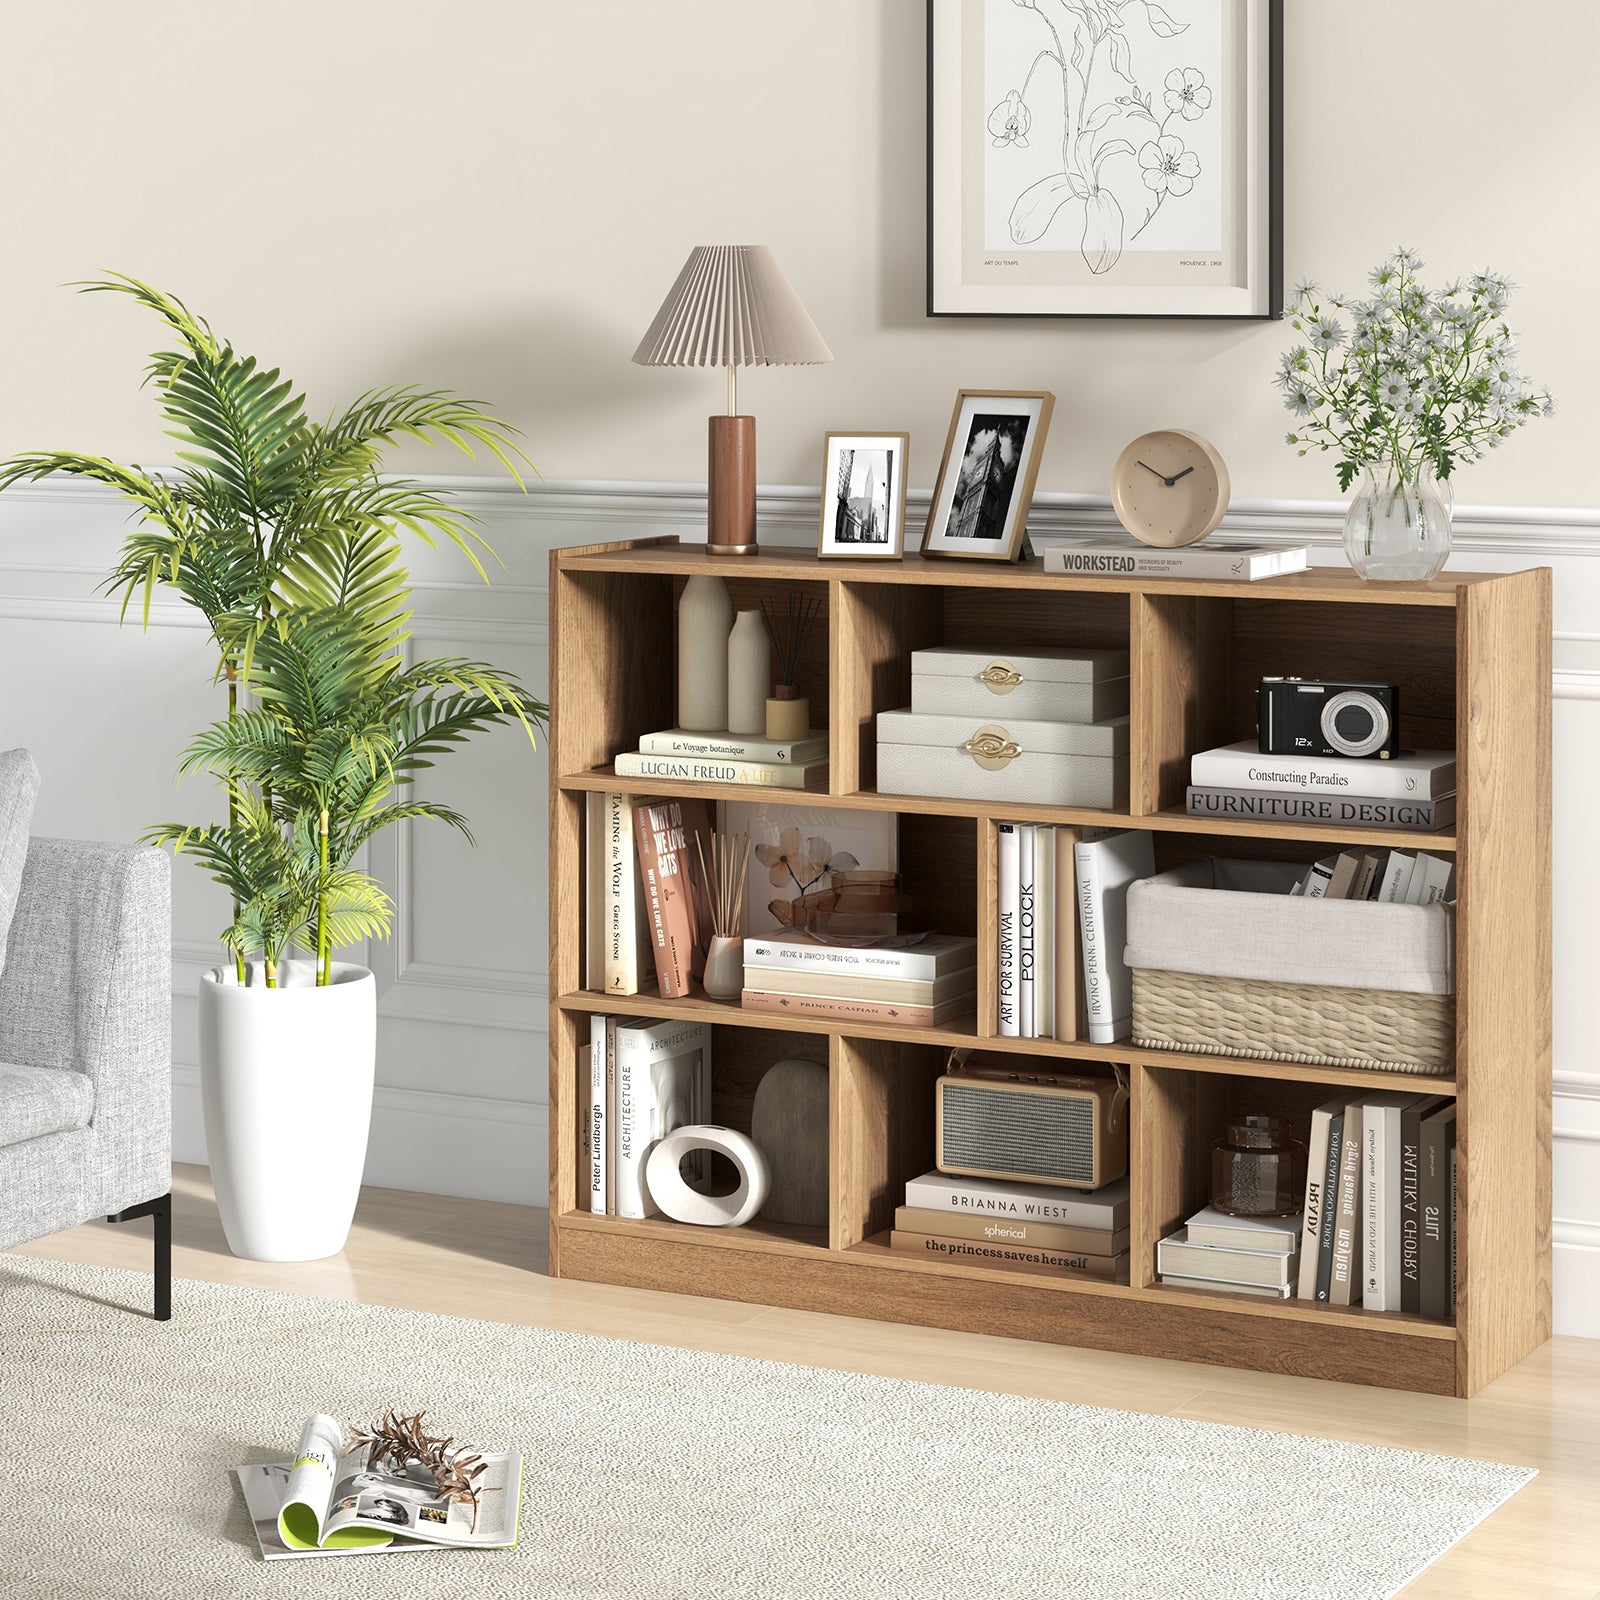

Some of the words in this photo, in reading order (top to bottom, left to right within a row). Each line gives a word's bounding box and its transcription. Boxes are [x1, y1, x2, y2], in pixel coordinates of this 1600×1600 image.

[1063, 554, 1135, 572] WORKSTEAD
[672, 742, 681, 750] Le
[683, 743, 708, 753] Voyage
[709, 744, 745, 755] botanique
[1294, 737, 1313, 747] 12x
[641, 762, 689, 777] LUCIAN
[694, 766, 736, 780] FREUD
[739, 769, 747, 782] A
[752, 770, 777, 783] LIFE
[1248, 768, 1307, 787] Constructing
[1309, 772, 1349, 786] Paradies
[612, 793, 622, 843] TAMING
[648, 804, 669, 832] WHY
[669, 802, 682, 827] DO
[1191, 793, 1332, 819] FURNITURE
[1340, 803, 1432, 825] DESIGN
[612, 846, 620, 860] the
[653, 831, 668, 855] WE
[667, 827, 687, 851] LOVE
[647, 868, 655, 886] WHY
[657, 853, 678, 878] CATS
[612, 861, 623, 897] WOLF
[650, 886, 658, 896] DO
[652, 897, 660, 908] WE
[1082, 878, 1095, 942] CENTENNIAL
[654, 908, 663, 928] LOVE
[657, 928, 665, 947] CATS
[1001, 911, 1013, 968] SURVIVAL
[1021, 883, 1034, 981] POLLOCK
[1088, 944, 1098, 974] PENN:
[1001, 971, 1012, 997] FOR
[1090, 977, 1101, 1015] IRVING
[800, 1002, 834, 1010] PRINCE
[838, 1005, 879, 1014] CASPIAN
[1001, 1001, 1013, 1025] ART
[650, 1026, 704, 1052] ARCHITECTURE
[622, 1065, 631, 1159] ARCHITECTURE
[592, 1104, 603, 1160] Lindbergh
[592, 1161, 601, 1192] Peter
[951, 1195, 1018, 1213] BRIANNA
[1024, 1204, 1068, 1218] WIEST
[984, 1224, 1026, 1240] spherical
[925, 1239, 947, 1252] the
[949, 1242, 1003, 1259] princess
[1004, 1250, 1040, 1263] saves
[1041, 1252, 1088, 1269] herself
